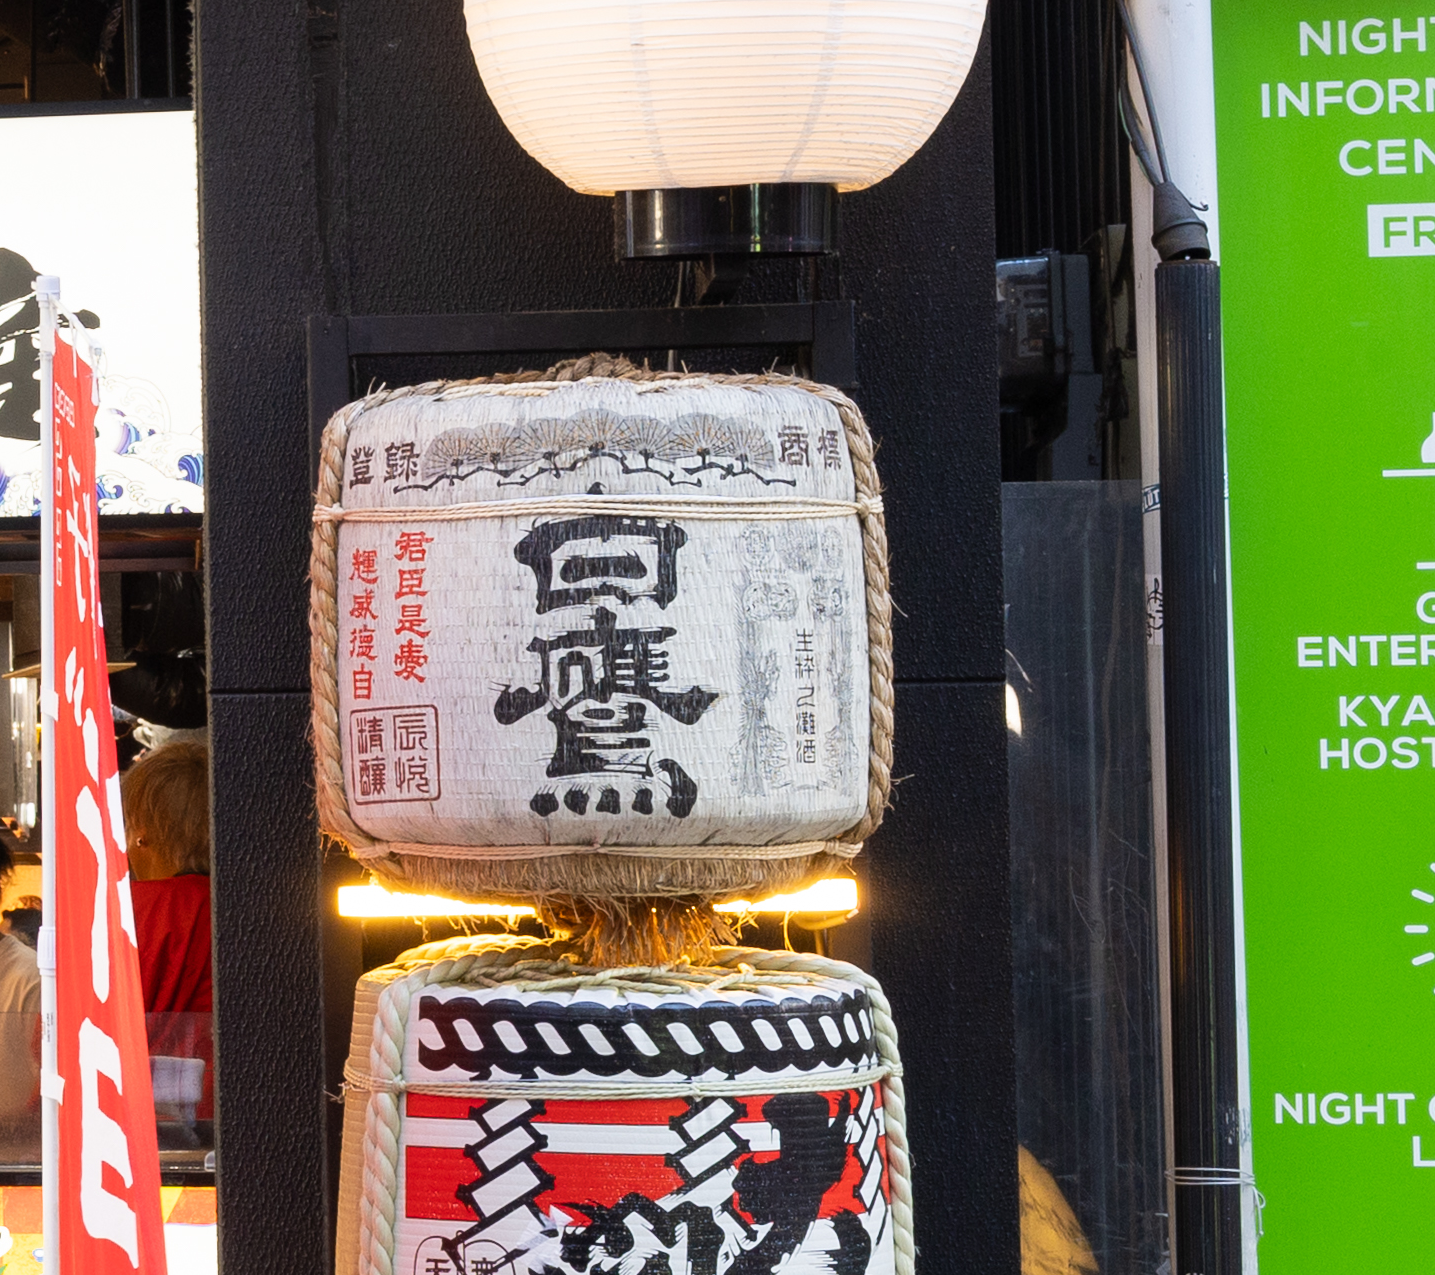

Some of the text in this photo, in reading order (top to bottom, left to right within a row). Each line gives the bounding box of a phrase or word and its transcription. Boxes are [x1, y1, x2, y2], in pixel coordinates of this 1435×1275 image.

[1298, 17, 1435, 56] NIGH
[1260, 77, 1435, 118] INFOR
[348, 440, 422, 490] 登録
[777, 424, 843, 472] 商標
[490, 482, 722, 820] 白鷹
[1339, 694, 1435, 728] KYA
[1274, 1091, 1416, 1126] NIGHT
